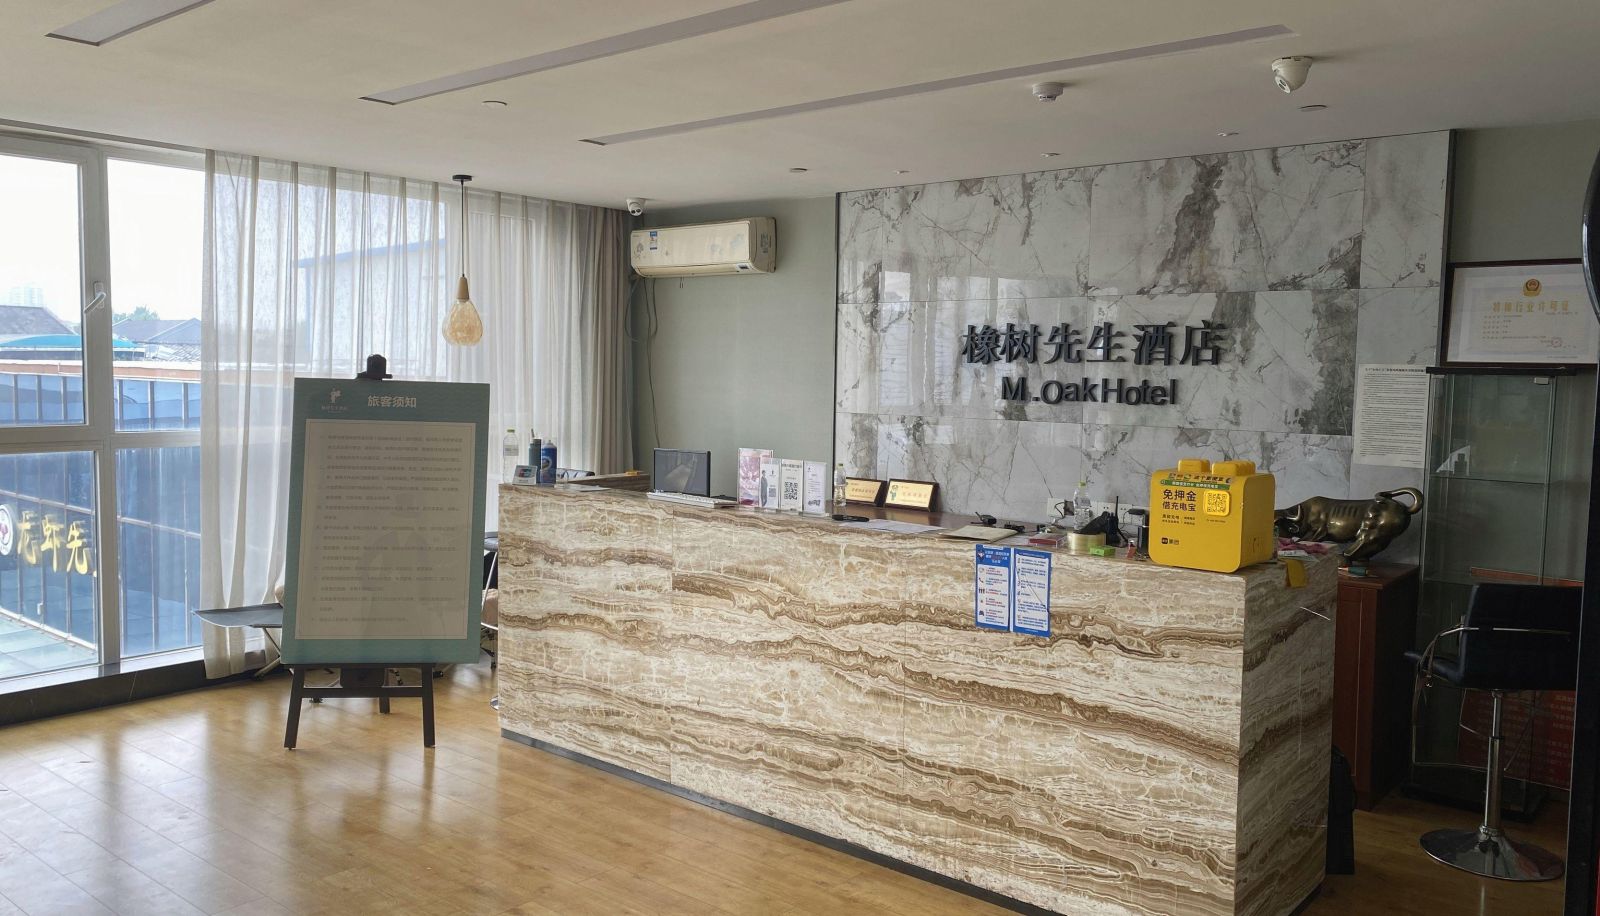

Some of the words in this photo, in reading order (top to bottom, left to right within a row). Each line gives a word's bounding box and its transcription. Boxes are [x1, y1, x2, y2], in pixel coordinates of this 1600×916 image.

[962, 319, 1226, 366] 橡树先生酒店
[367, 395, 417, 408] 旅客须知
[1163, 489, 1196, 501] 免押金
[1162, 501, 1196, 512] 借充电宝
[17, 511, 97, 577] 龙虾先
